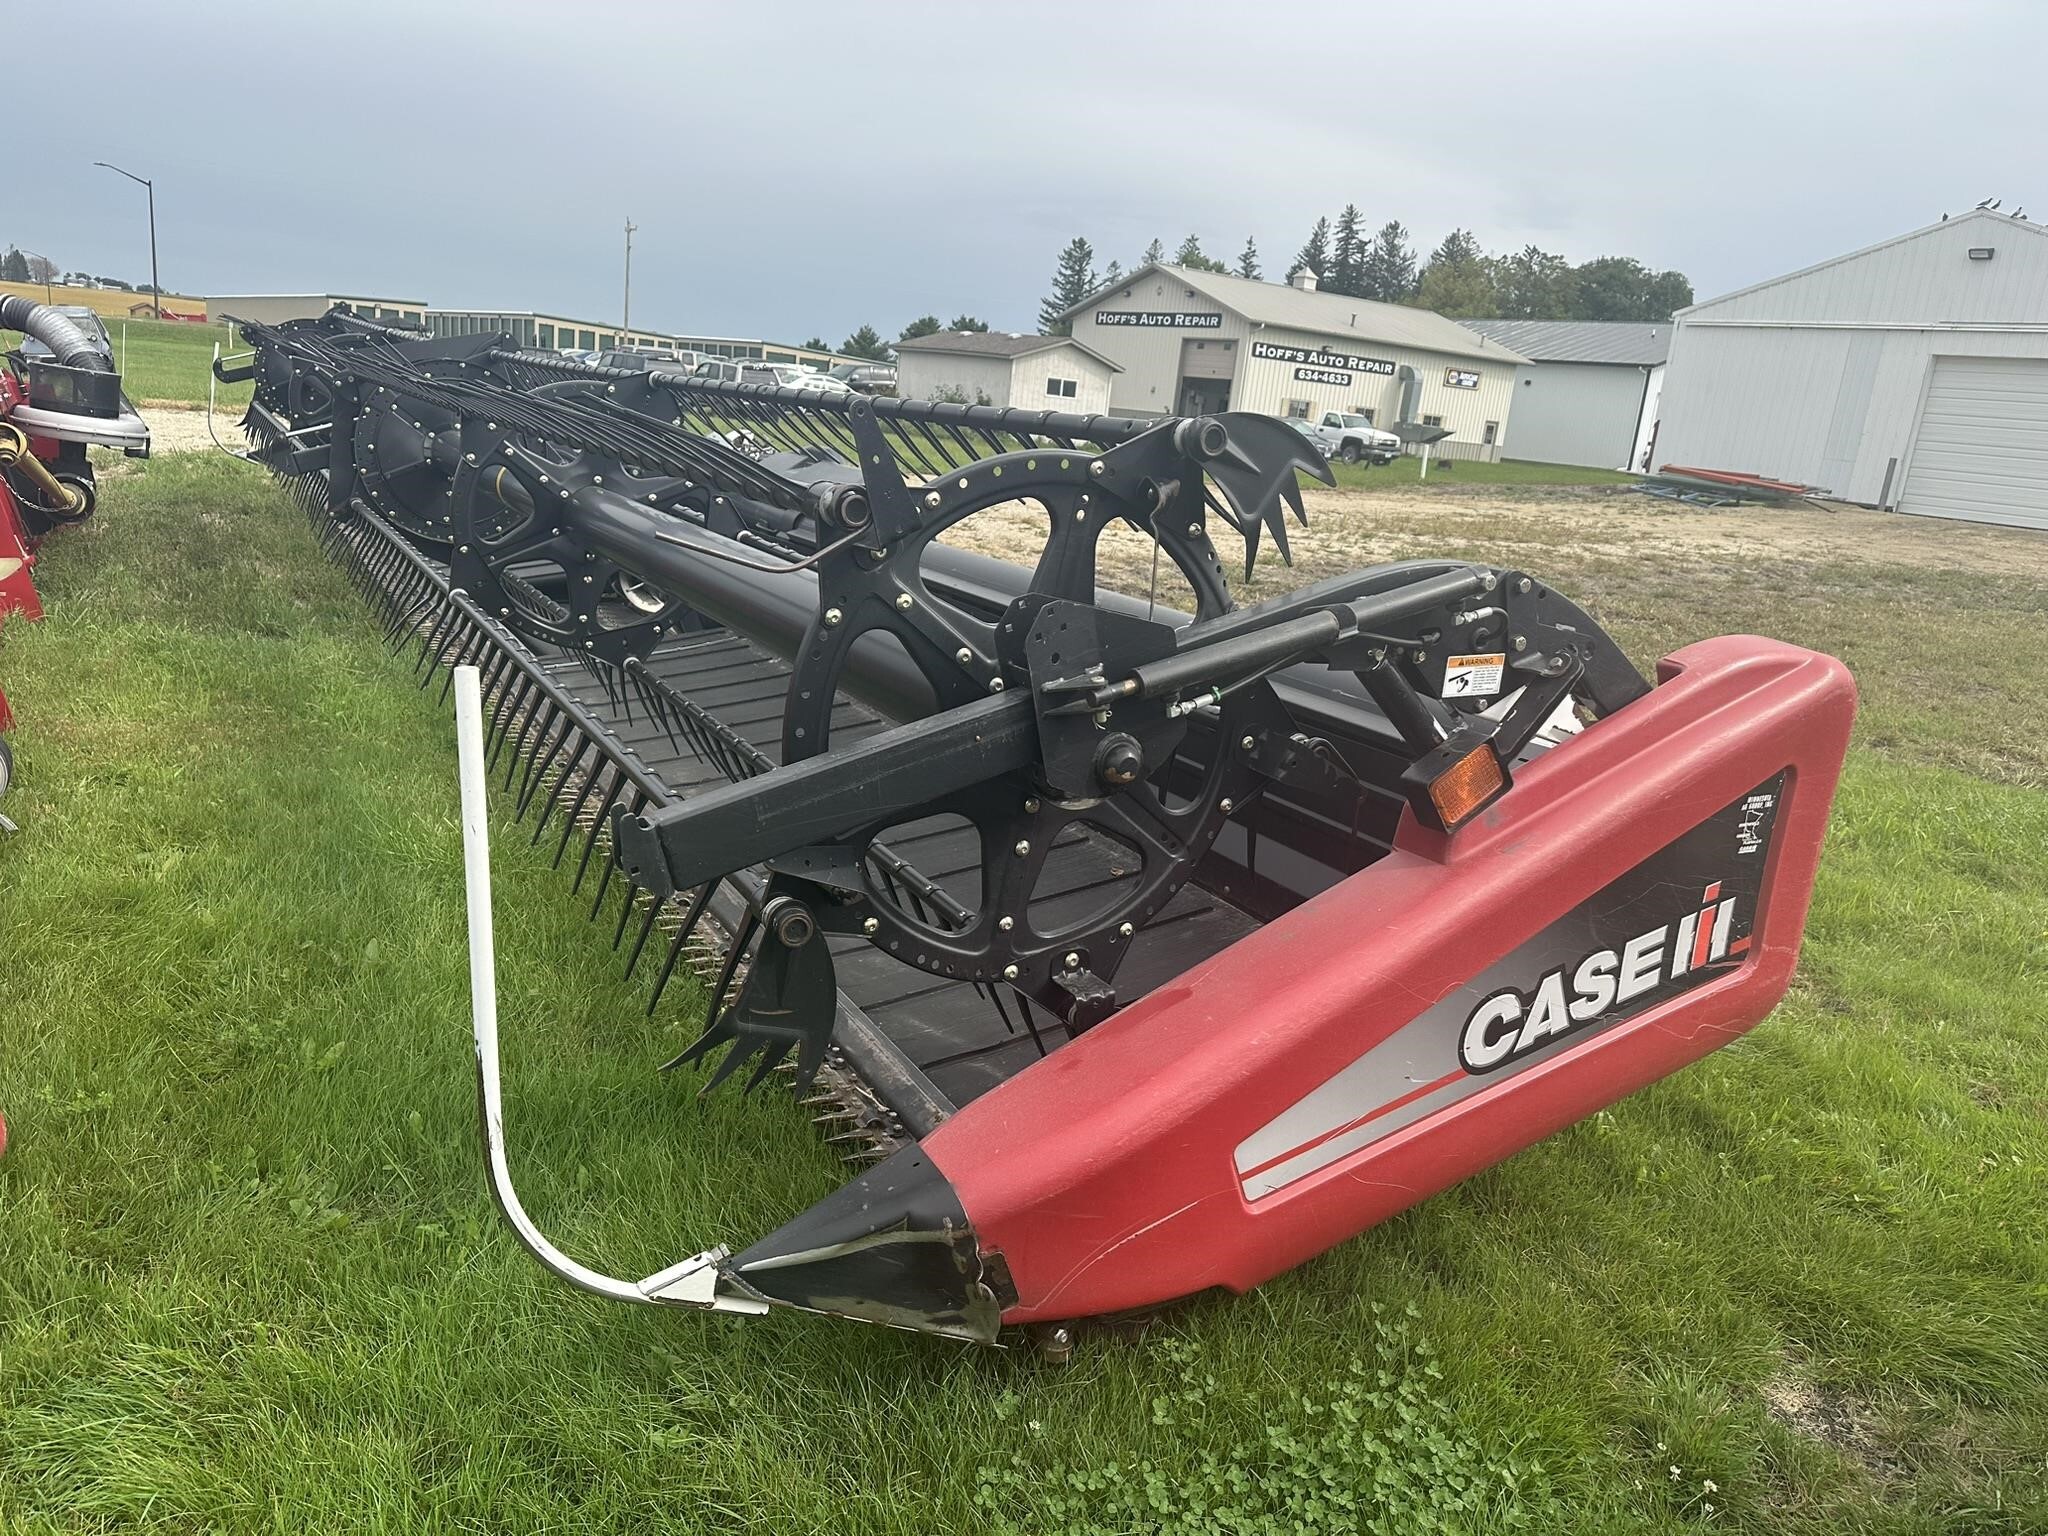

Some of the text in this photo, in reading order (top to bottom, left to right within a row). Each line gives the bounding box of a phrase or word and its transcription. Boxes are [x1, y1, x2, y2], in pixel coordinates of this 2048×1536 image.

[1097, 312, 1219, 327] HOFF'S AUTO REPAIR
[1255, 343, 1393, 374] HOFF'S AUTO REPAIR
[1463, 924, 1668, 1068] CASE
